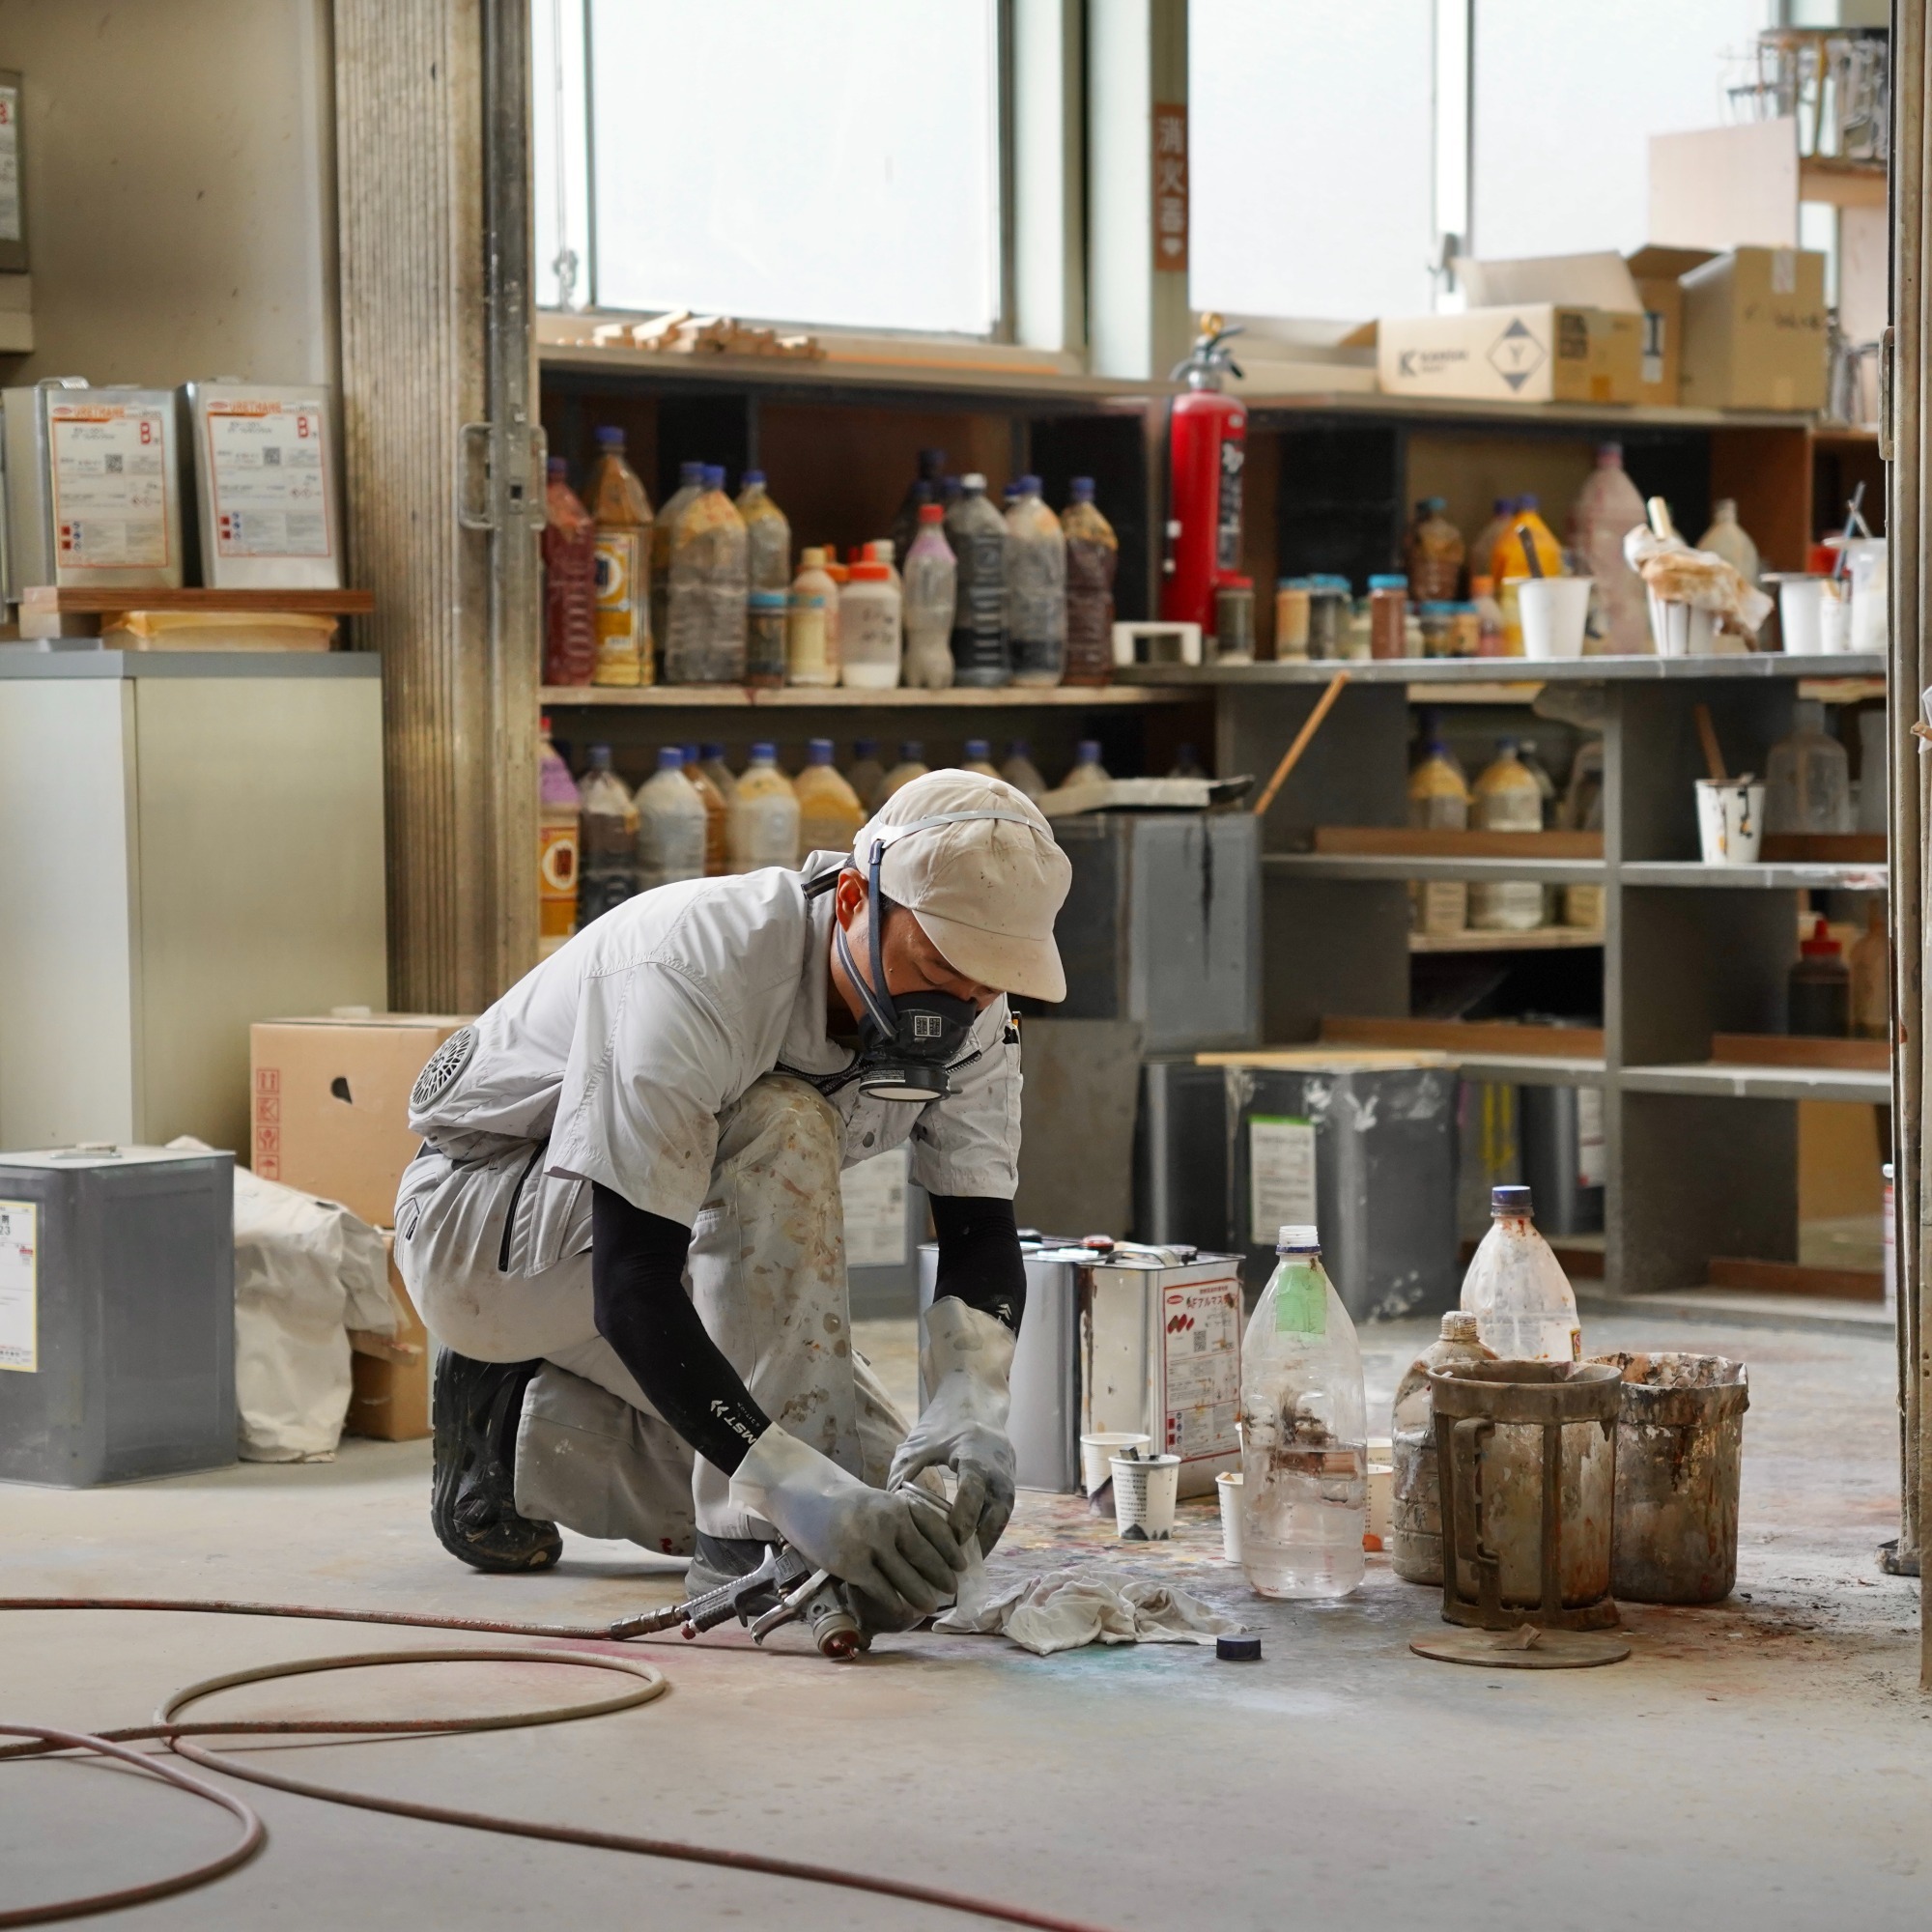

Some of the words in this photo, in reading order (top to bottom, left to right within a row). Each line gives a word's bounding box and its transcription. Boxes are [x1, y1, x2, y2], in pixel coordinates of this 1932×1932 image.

[140, 421, 151, 444] B
[297, 416, 308, 439] B
[724, 1416, 758, 1445] MST
